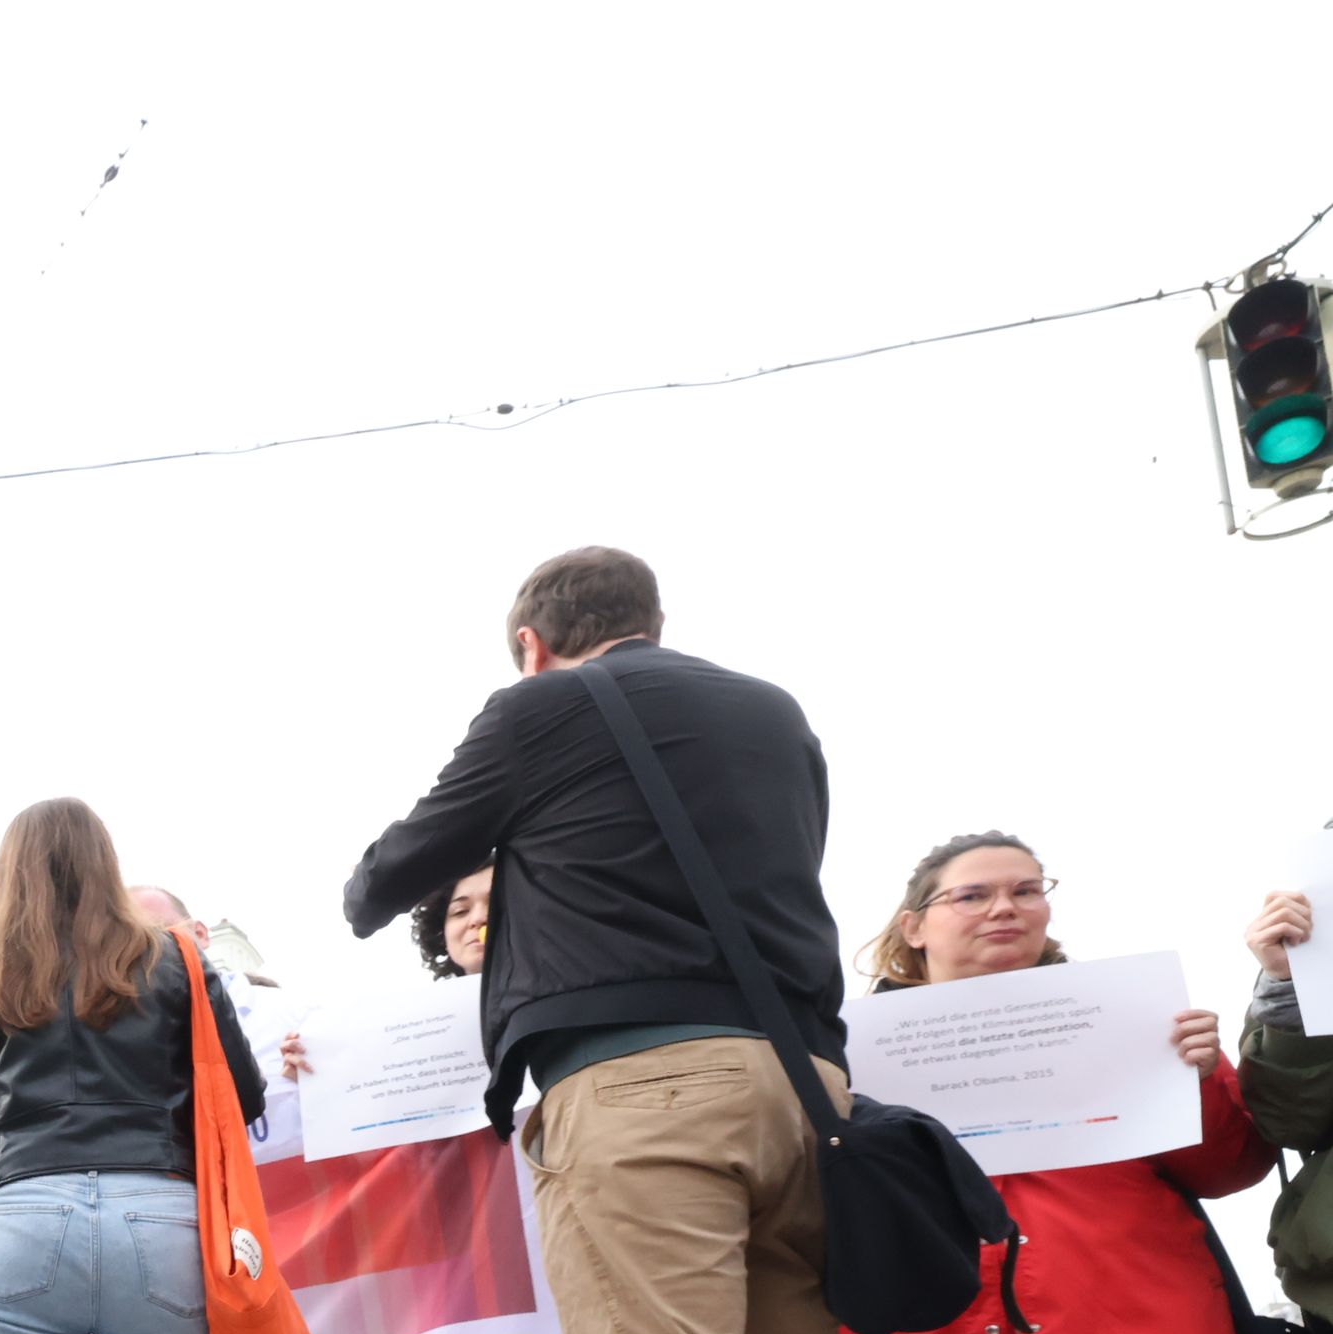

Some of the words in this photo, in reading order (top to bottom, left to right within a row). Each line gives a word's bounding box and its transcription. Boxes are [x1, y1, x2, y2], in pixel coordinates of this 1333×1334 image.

[875, 1037, 893, 1046] die
[895, 1034, 914, 1043] die
[916, 1028, 955, 1039] Folgen
[957, 1025, 978, 1033] des
[980, 1011, 1065, 1029] Klimawandels
[923, 1014, 947, 1026] sind
[949, 1013, 967, 1021] die
[970, 1008, 1001, 1018] erste
[884, 1047, 908, 1057] und
[910, 1045, 928, 1053] wir
[932, 1040, 956, 1050] sind
[958, 1038, 977, 1046] die
[979, 1032, 1015, 1042] letzte
[1018, 1022, 1094, 1038] Generation,
[902, 1059, 919, 1067] die
[921, 1055, 957, 1064] etwas
[960, 1046, 1011, 1059] dagegen
[1013, 1043, 1035, 1052] tun
[931, 1080, 970, 1092] Barack
[972, 1075, 1020, 1087] Obama,
[1024, 1068, 1054, 1080] 2015
